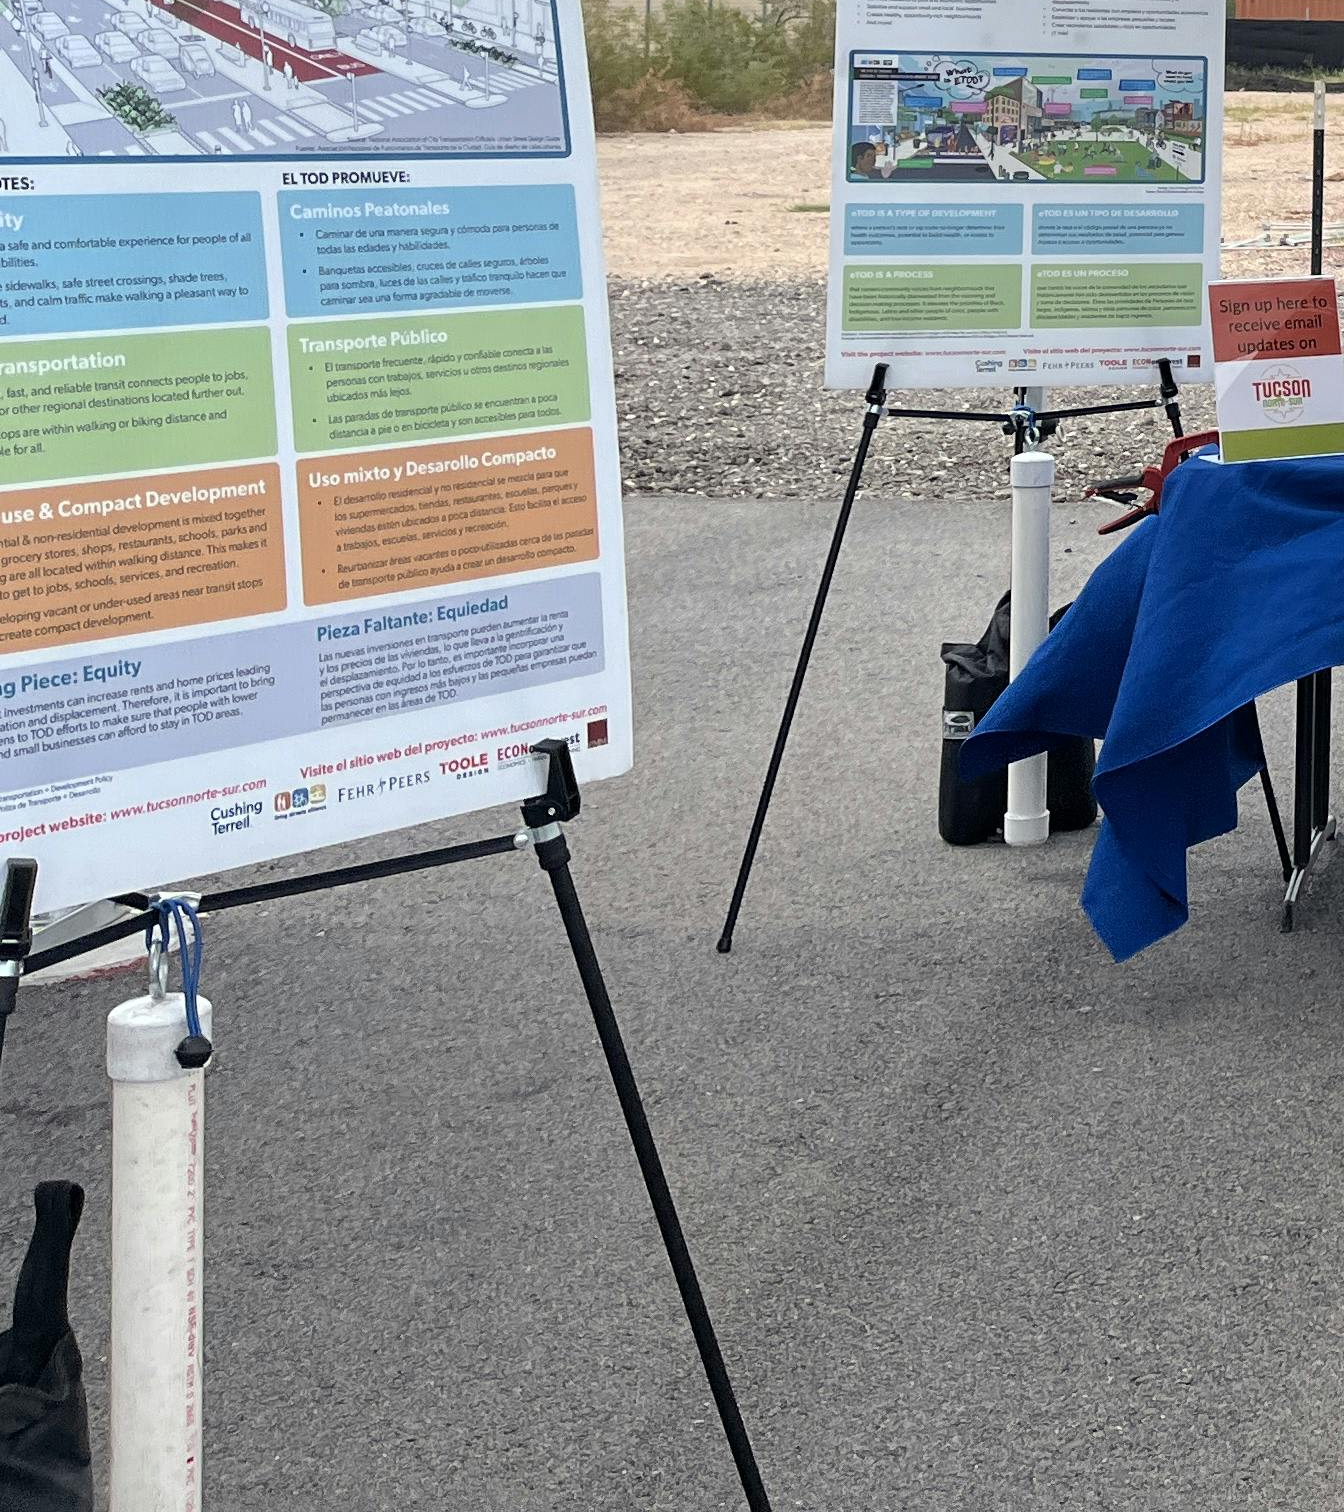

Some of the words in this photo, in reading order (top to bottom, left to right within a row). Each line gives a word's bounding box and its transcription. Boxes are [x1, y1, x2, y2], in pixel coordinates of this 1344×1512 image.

[282, 172, 298, 185] EL
[299, 171, 329, 184] TOD
[331, 170, 410, 183] PROMUEVE:
[289, 203, 362, 219] Caminos
[364, 201, 450, 216] Peatonales
[1219, 299, 1250, 315] Sign
[1254, 300, 1272, 313] up
[1275, 296, 1309, 309] here
[1311, 295, 1327, 308] to
[1228, 318, 1280, 332] receive
[1284, 314, 1322, 329] email
[298, 334, 387, 352] Transporte
[390, 328, 448, 345] Público
[1237, 338, 1294, 354] updates
[1298, 338, 1316, 349] on
[1251, 379, 1311, 401] TUCSON
[308, 471, 340, 487] Uso
[343, 466, 390, 483] mixto
[392, 465, 402, 481] y
[405, 454, 478, 476] Desarollo
[480, 446, 556, 466] Compacto
[38, 502, 54, 519] &
[57, 494, 142, 517] Compact
[145, 480, 266, 506] Development
[316, 624, 360, 641] Pieza
[363, 611, 432, 633] Faltante:
[436, 595, 508, 621] Equiedad
[20, 671, 78, 692] Piece:
[82, 659, 141, 682] Equity
[438, 752, 488, 774] TOOLE
[337, 783, 374, 802] FEHR
[388, 770, 430, 790] PEERS
[210, 801, 262, 820] Cushing
[211, 814, 250, 834] Terrell
